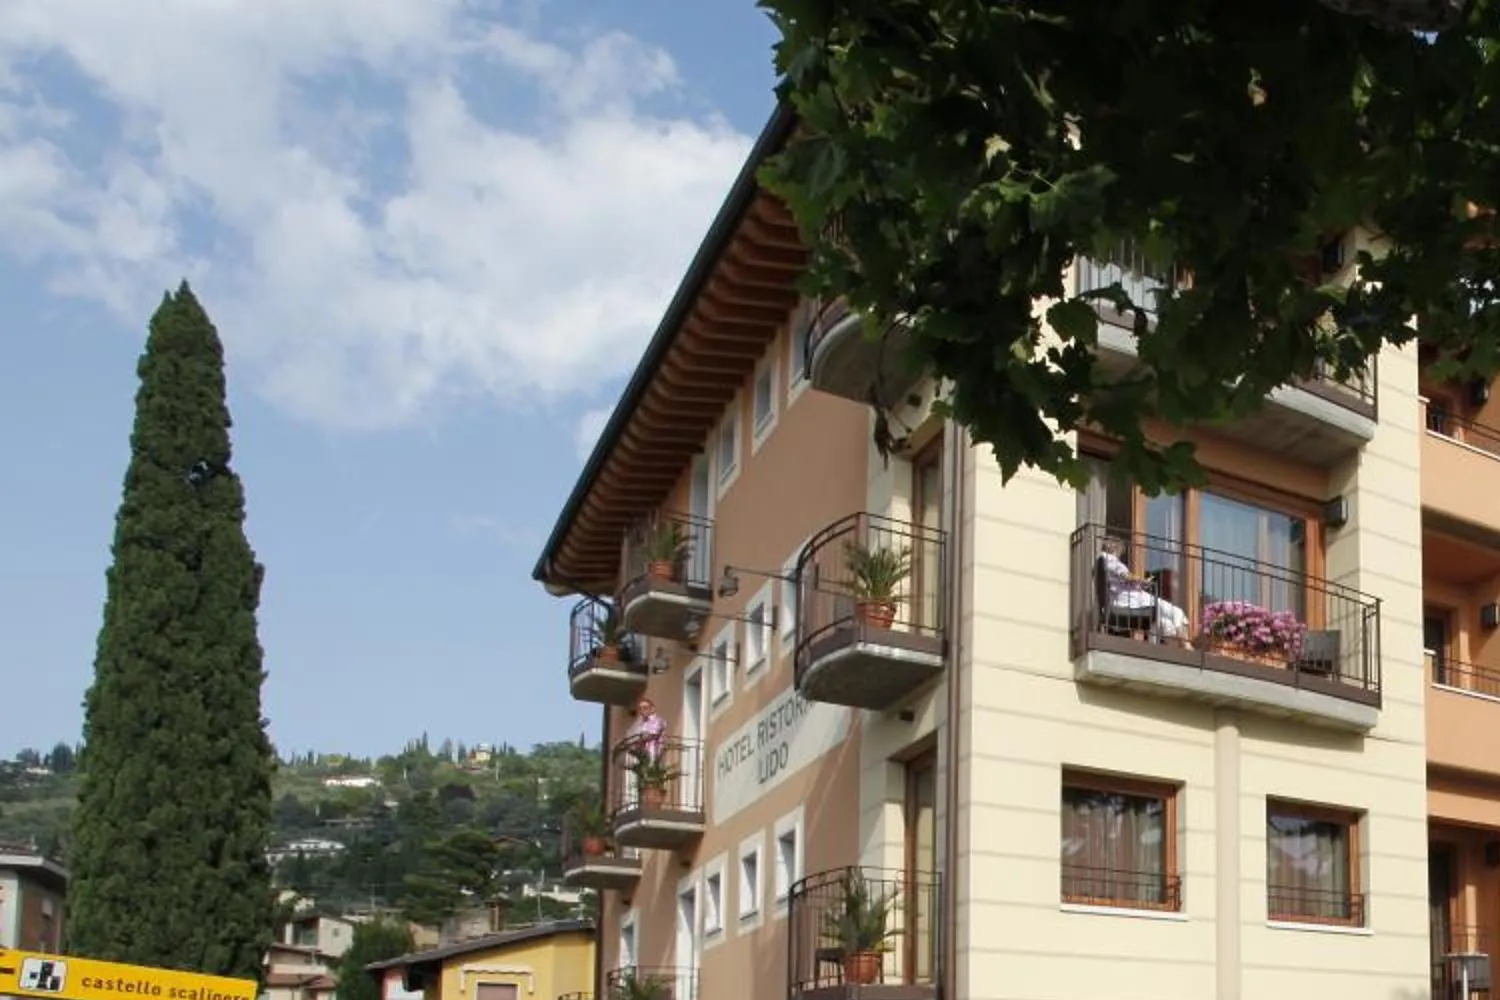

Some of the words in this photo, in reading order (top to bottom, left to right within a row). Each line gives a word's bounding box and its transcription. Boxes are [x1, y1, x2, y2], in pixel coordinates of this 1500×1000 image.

[718, 736, 754, 780] HOTEL
[758, 741, 789, 785] LIDO
[81, 975, 161, 997] castello
